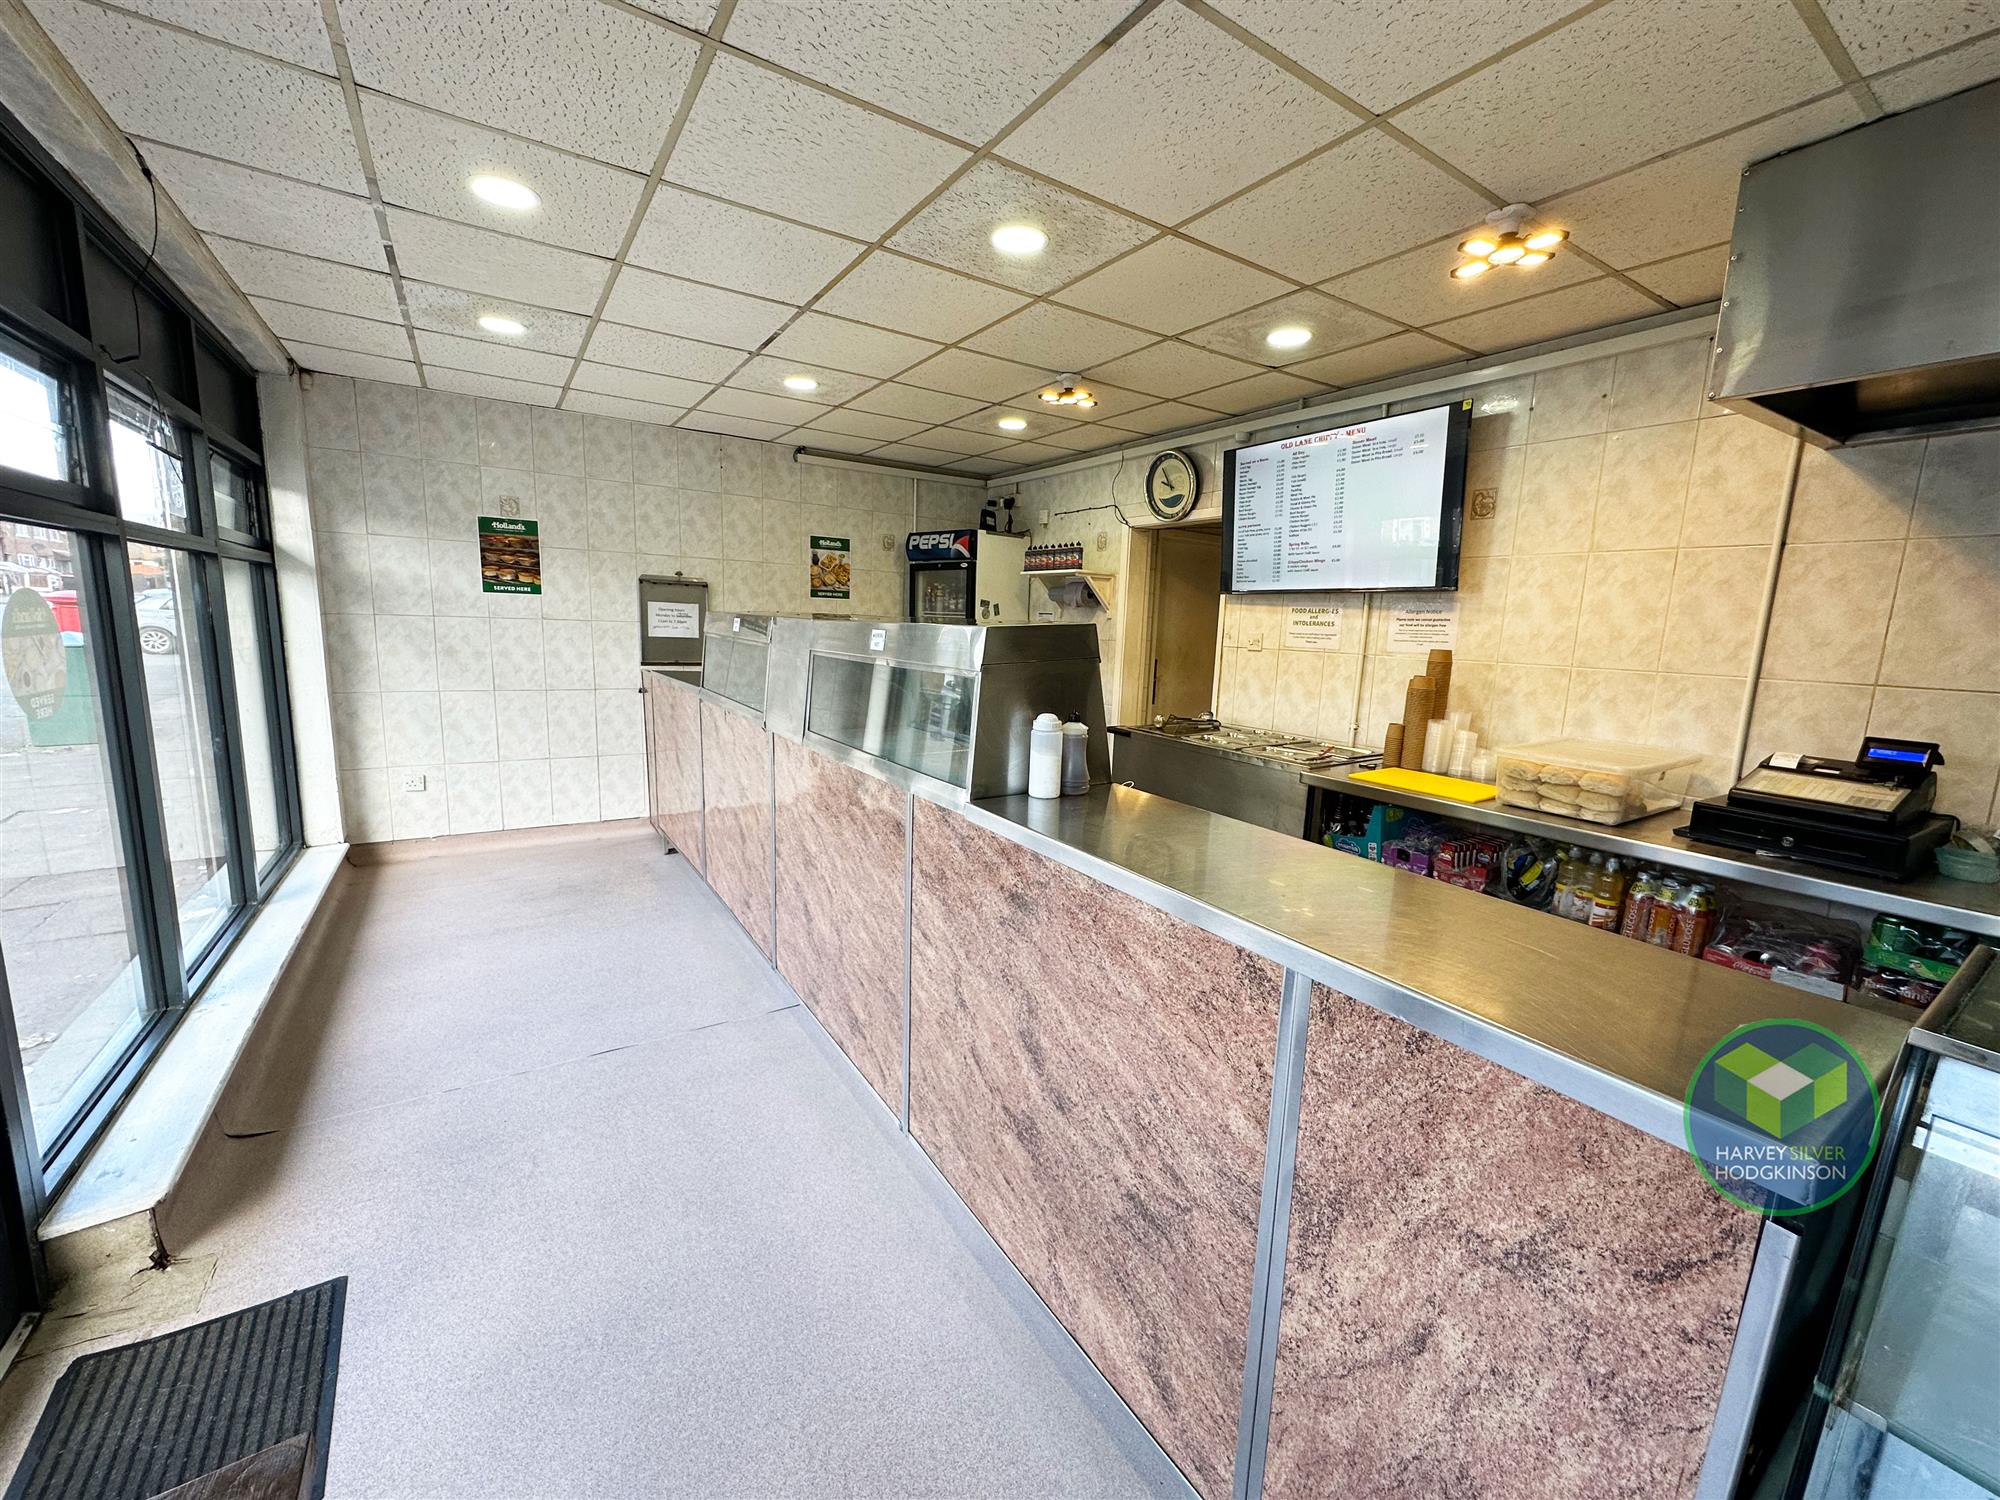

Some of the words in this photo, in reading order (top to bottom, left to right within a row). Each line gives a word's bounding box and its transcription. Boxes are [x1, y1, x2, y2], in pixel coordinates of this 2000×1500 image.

[1281, 442, 1293, 450] OLD
[1295, 438, 1312, 447] LANE
[1345, 427, 1366, 436] MENU
[492, 521, 526, 530] Holland's
[909, 533, 955, 550] PEPSI
[1682, 918, 1696, 956] GLUCOSE
